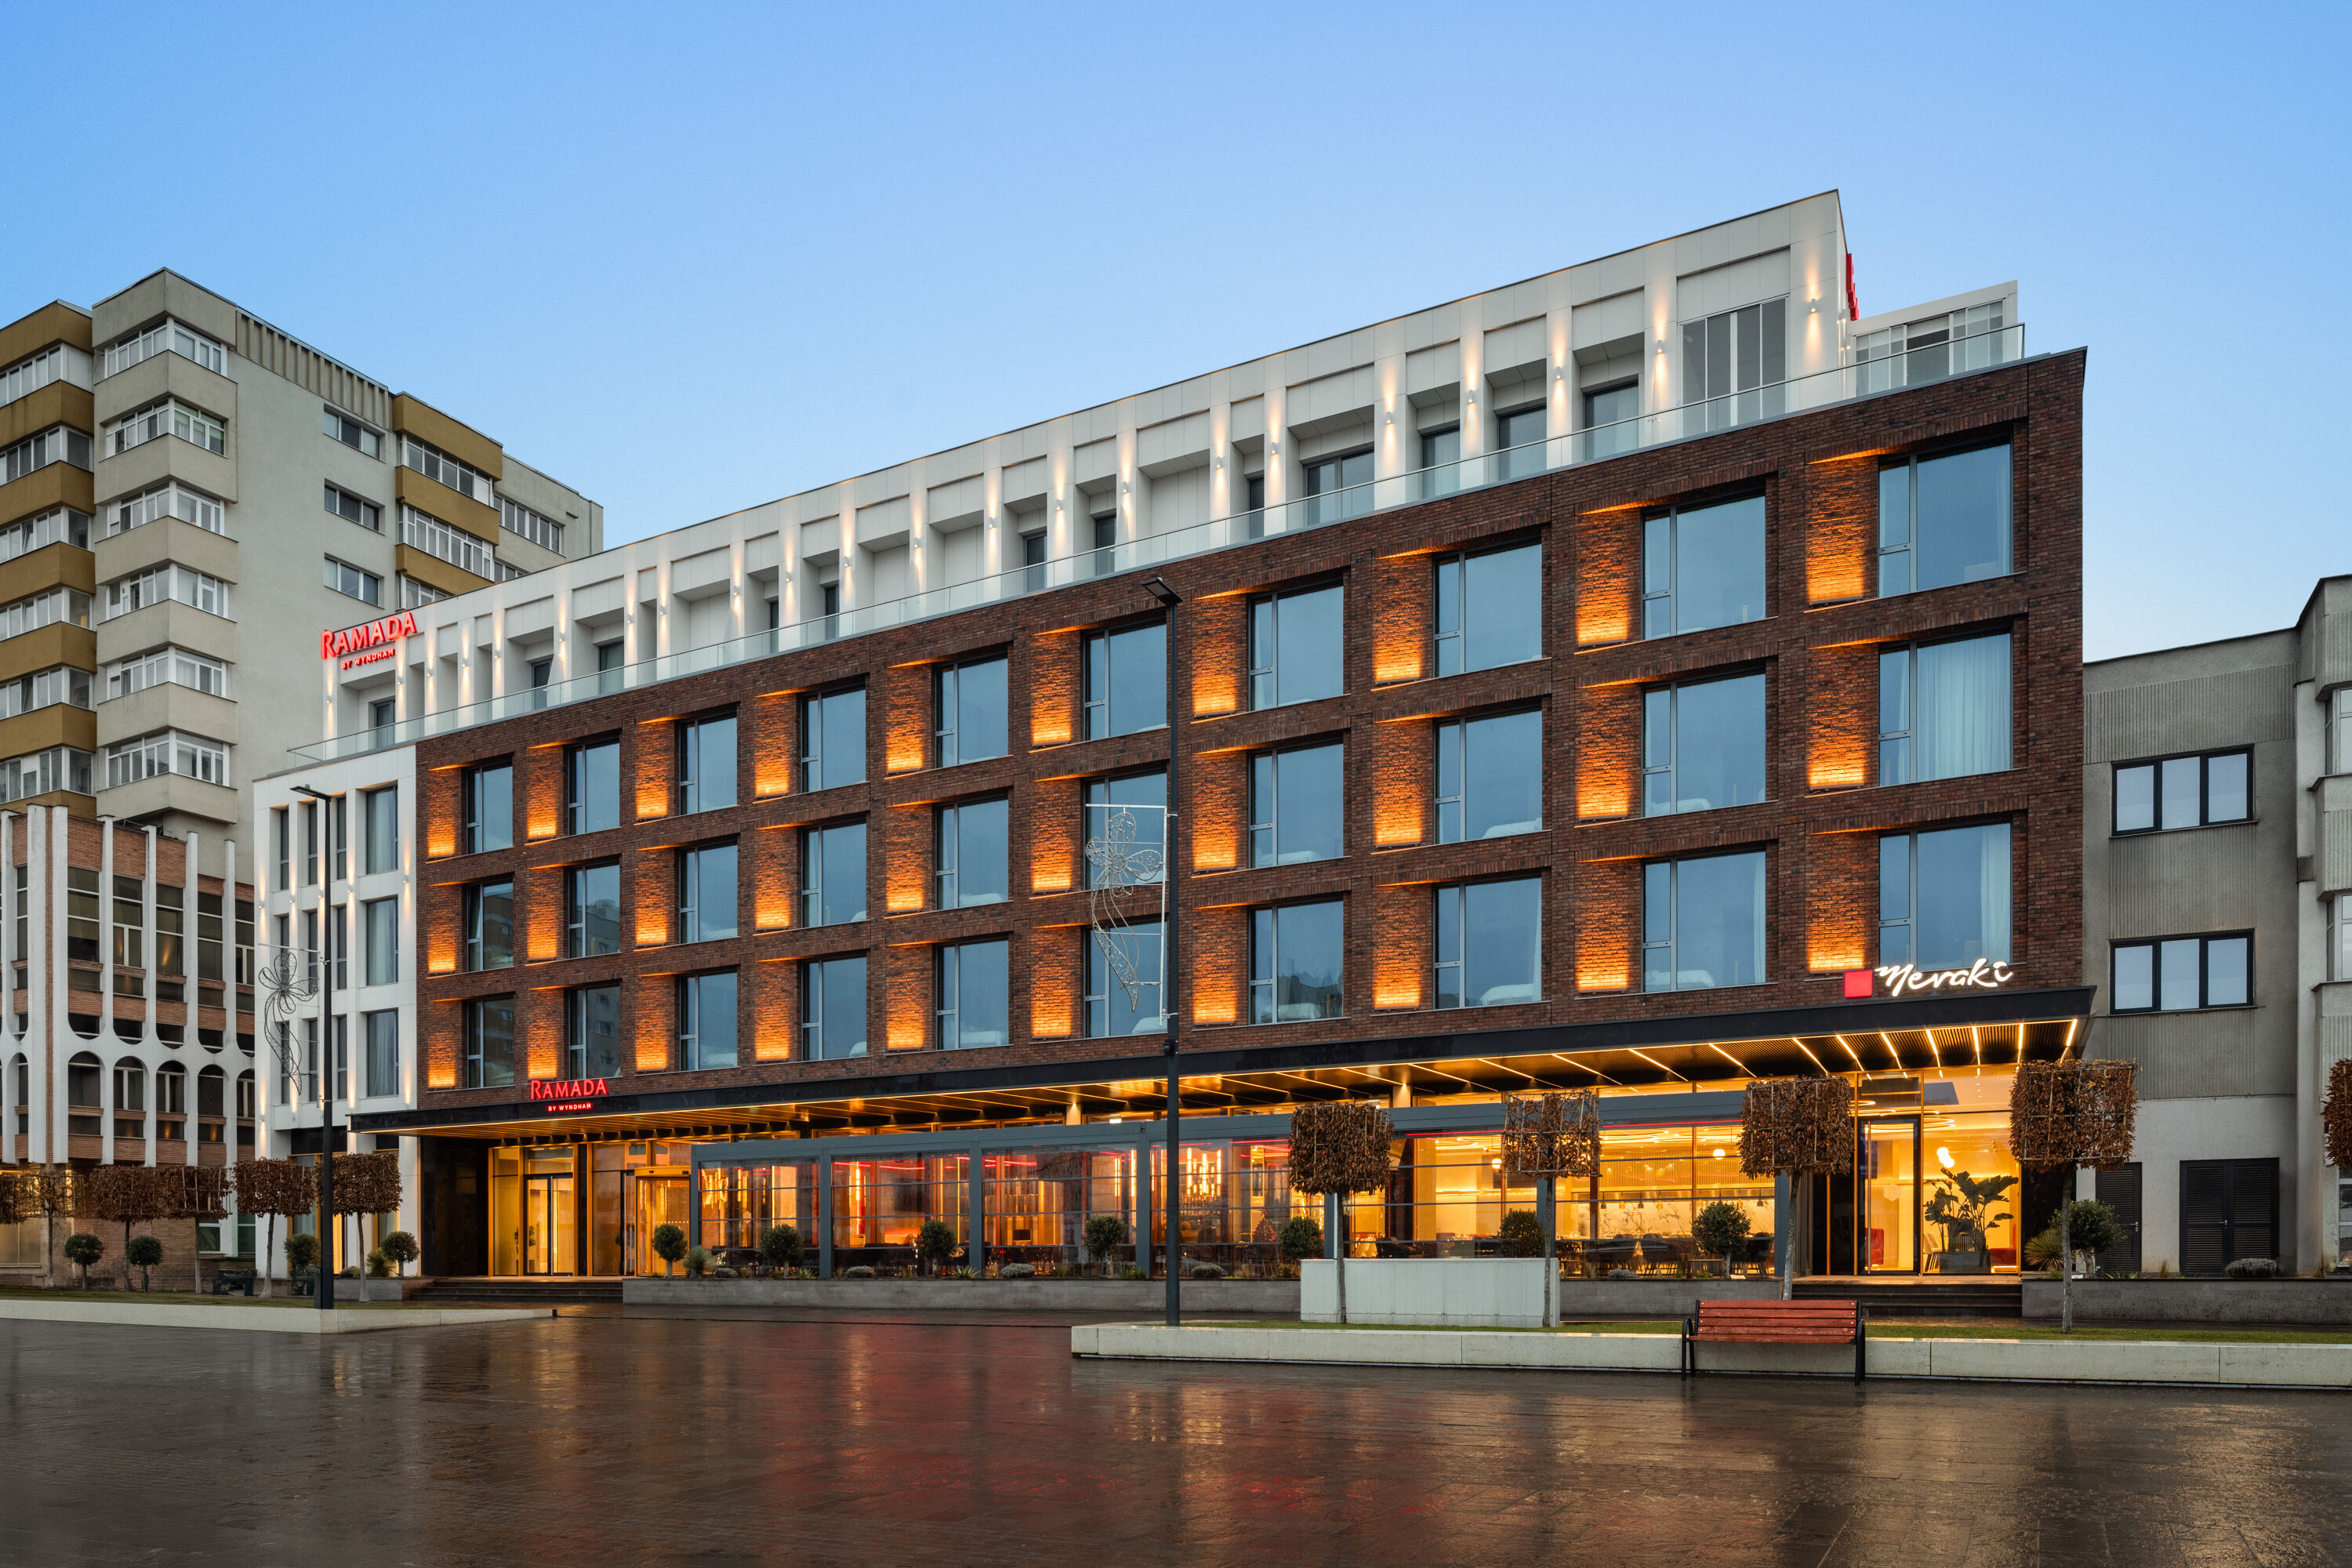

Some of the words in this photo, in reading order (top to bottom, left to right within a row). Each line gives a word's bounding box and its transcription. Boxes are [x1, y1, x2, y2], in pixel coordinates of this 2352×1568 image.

[321, 612, 417, 659] RAMADA
[340, 660, 353, 670] BY
[354, 648, 395, 666] WYNDHAM
[531, 1078, 608, 1100] RAMADA
[558, 1102, 591, 1111] WYNDHAM
